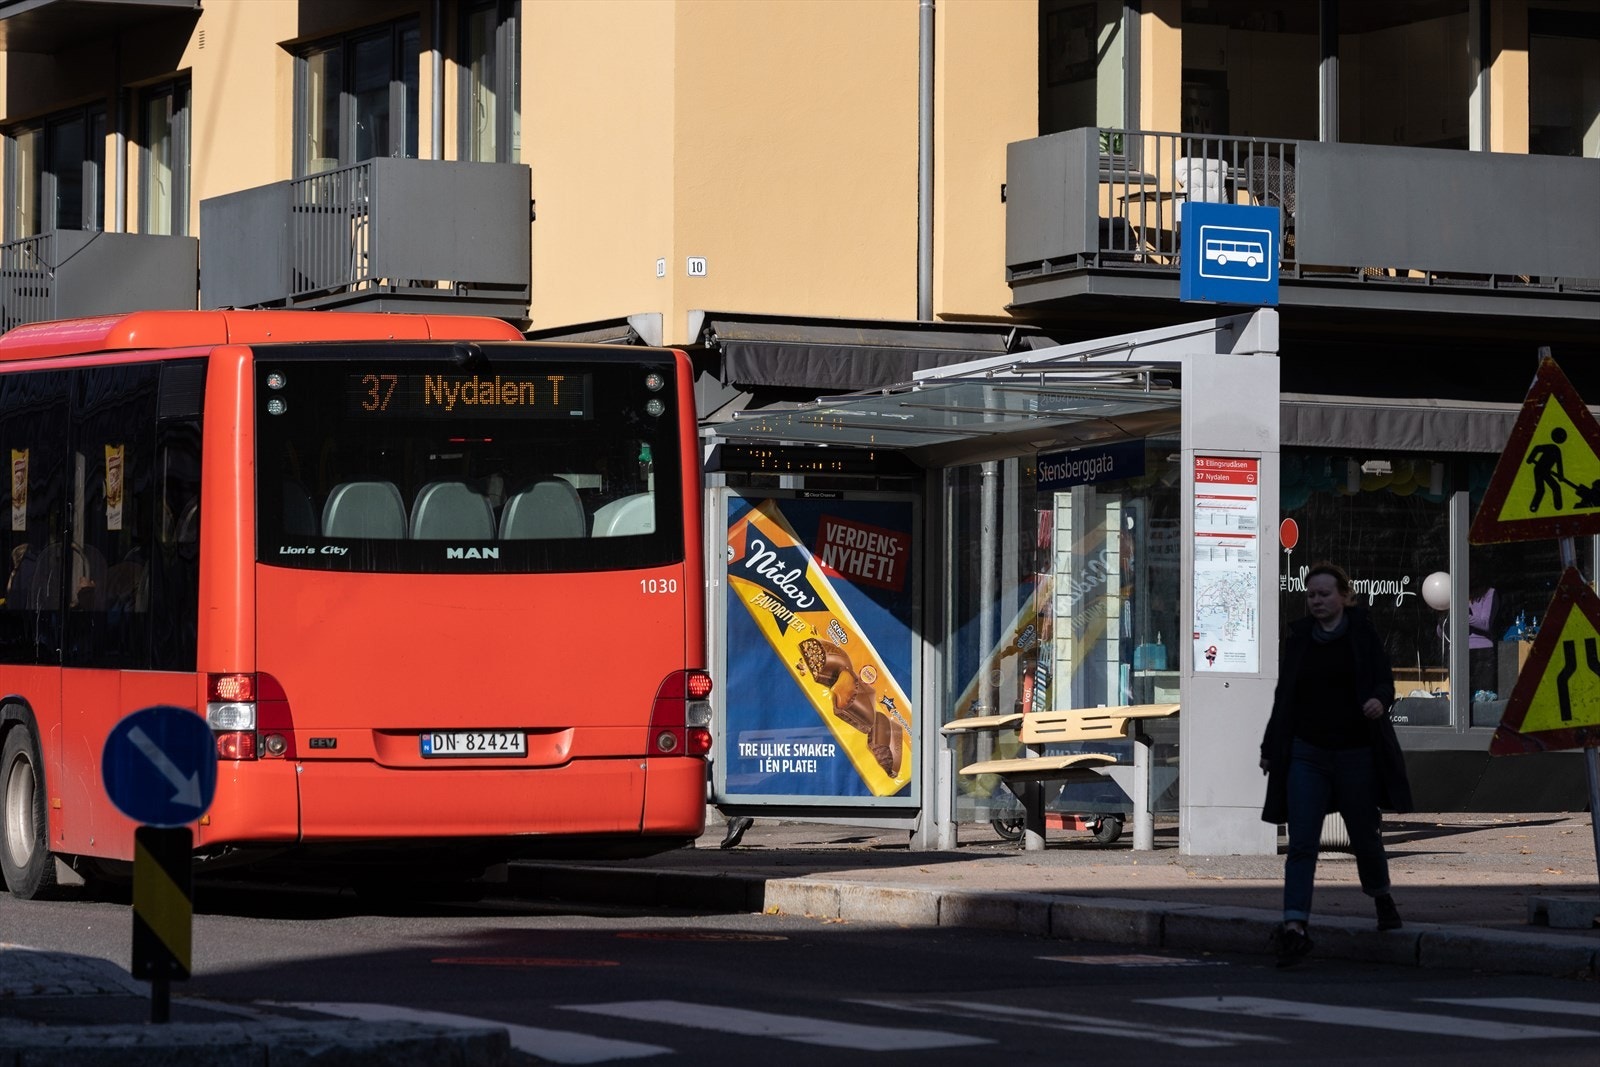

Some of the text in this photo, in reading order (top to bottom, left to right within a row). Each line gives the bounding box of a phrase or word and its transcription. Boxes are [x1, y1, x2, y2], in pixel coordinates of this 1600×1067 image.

[692, 261, 702, 273] 10
[362, 374, 564, 412] 37 Nydalen T
[1038, 453, 1114, 482] Stensberggata
[1196, 459, 1204, 467] 33
[1206, 474, 1229, 482] Nydalen
[826, 522, 904, 555] VERDENS-
[279, 546, 348, 556] Lion's City
[446, 547, 500, 560] MAN
[821, 543, 894, 582] NYHET!
[745, 539, 815, 610] Nidar
[640, 579, 677, 594] 1030
[750, 592, 806, 634] FAVORITTER
[310, 738, 336, 748] EEV
[433, 733, 456, 750] DN
[466, 733, 520, 750] 82424
[739, 743, 835, 757] TRE ULIKE SMAKER
[759, 756, 817, 773] I ÉN PLATE!
